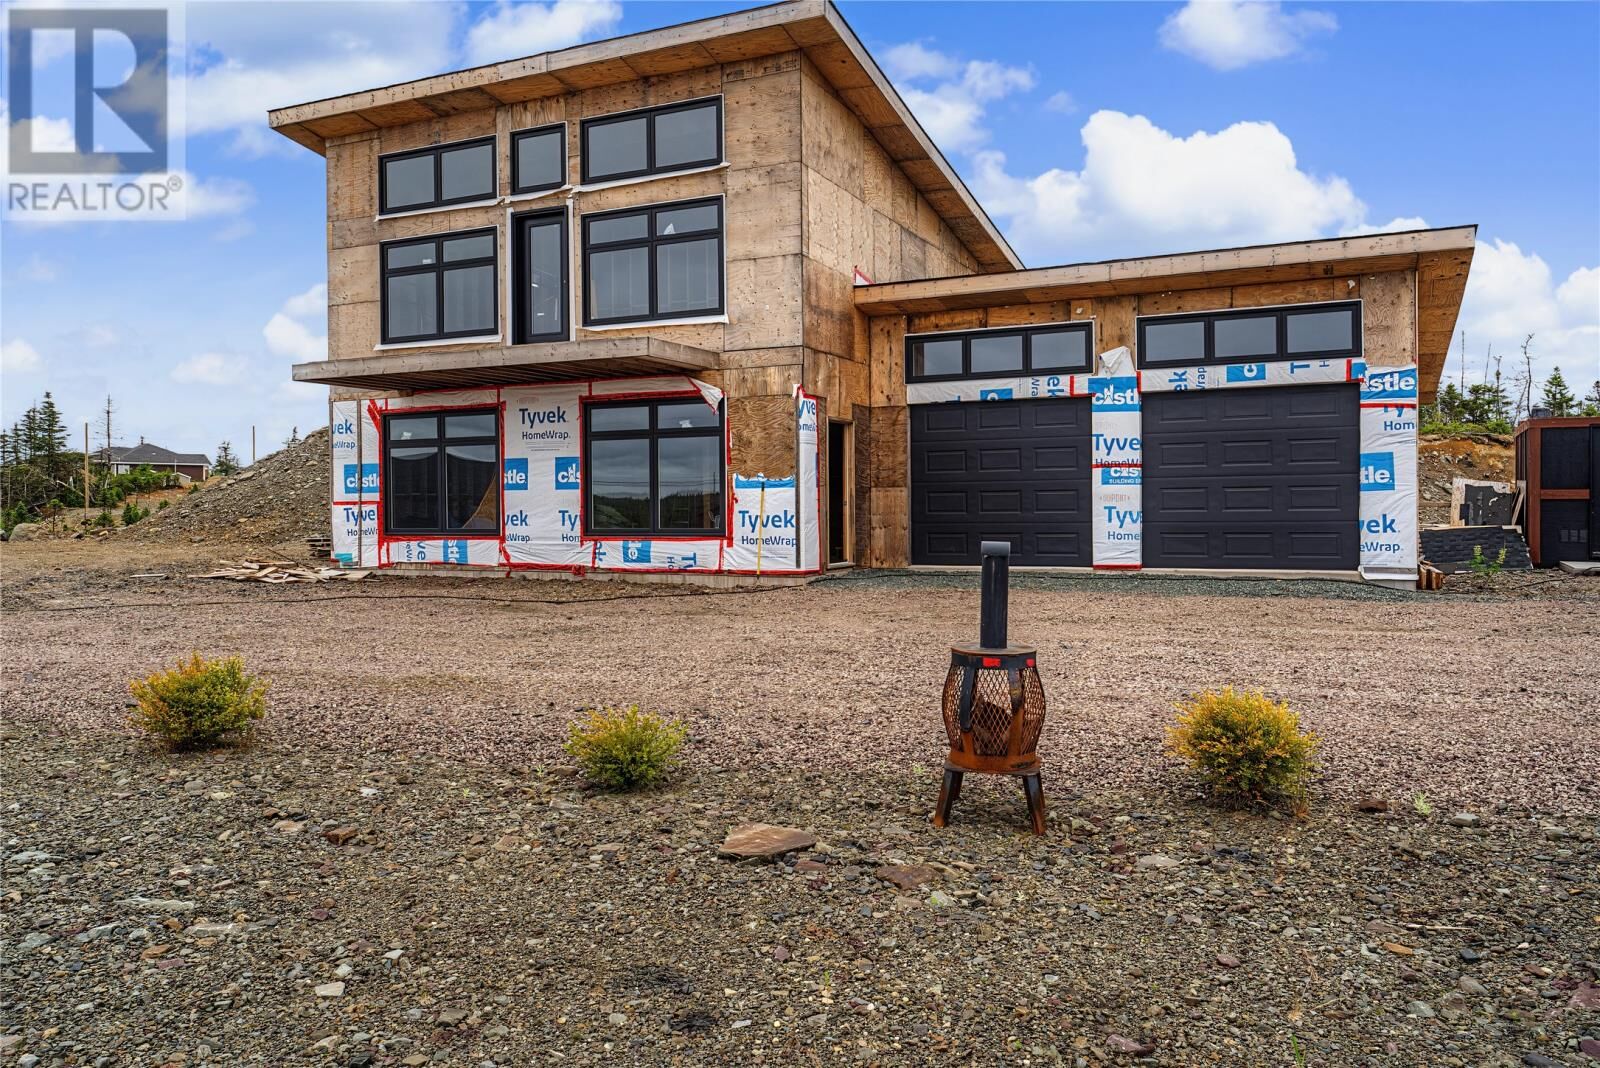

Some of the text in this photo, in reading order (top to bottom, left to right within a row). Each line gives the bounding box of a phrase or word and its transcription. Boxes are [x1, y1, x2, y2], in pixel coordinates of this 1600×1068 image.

[518, 406, 567, 429] Tyvek
[521, 430, 569, 440] HomeWrap
[738, 509, 795, 533] Tyvek
